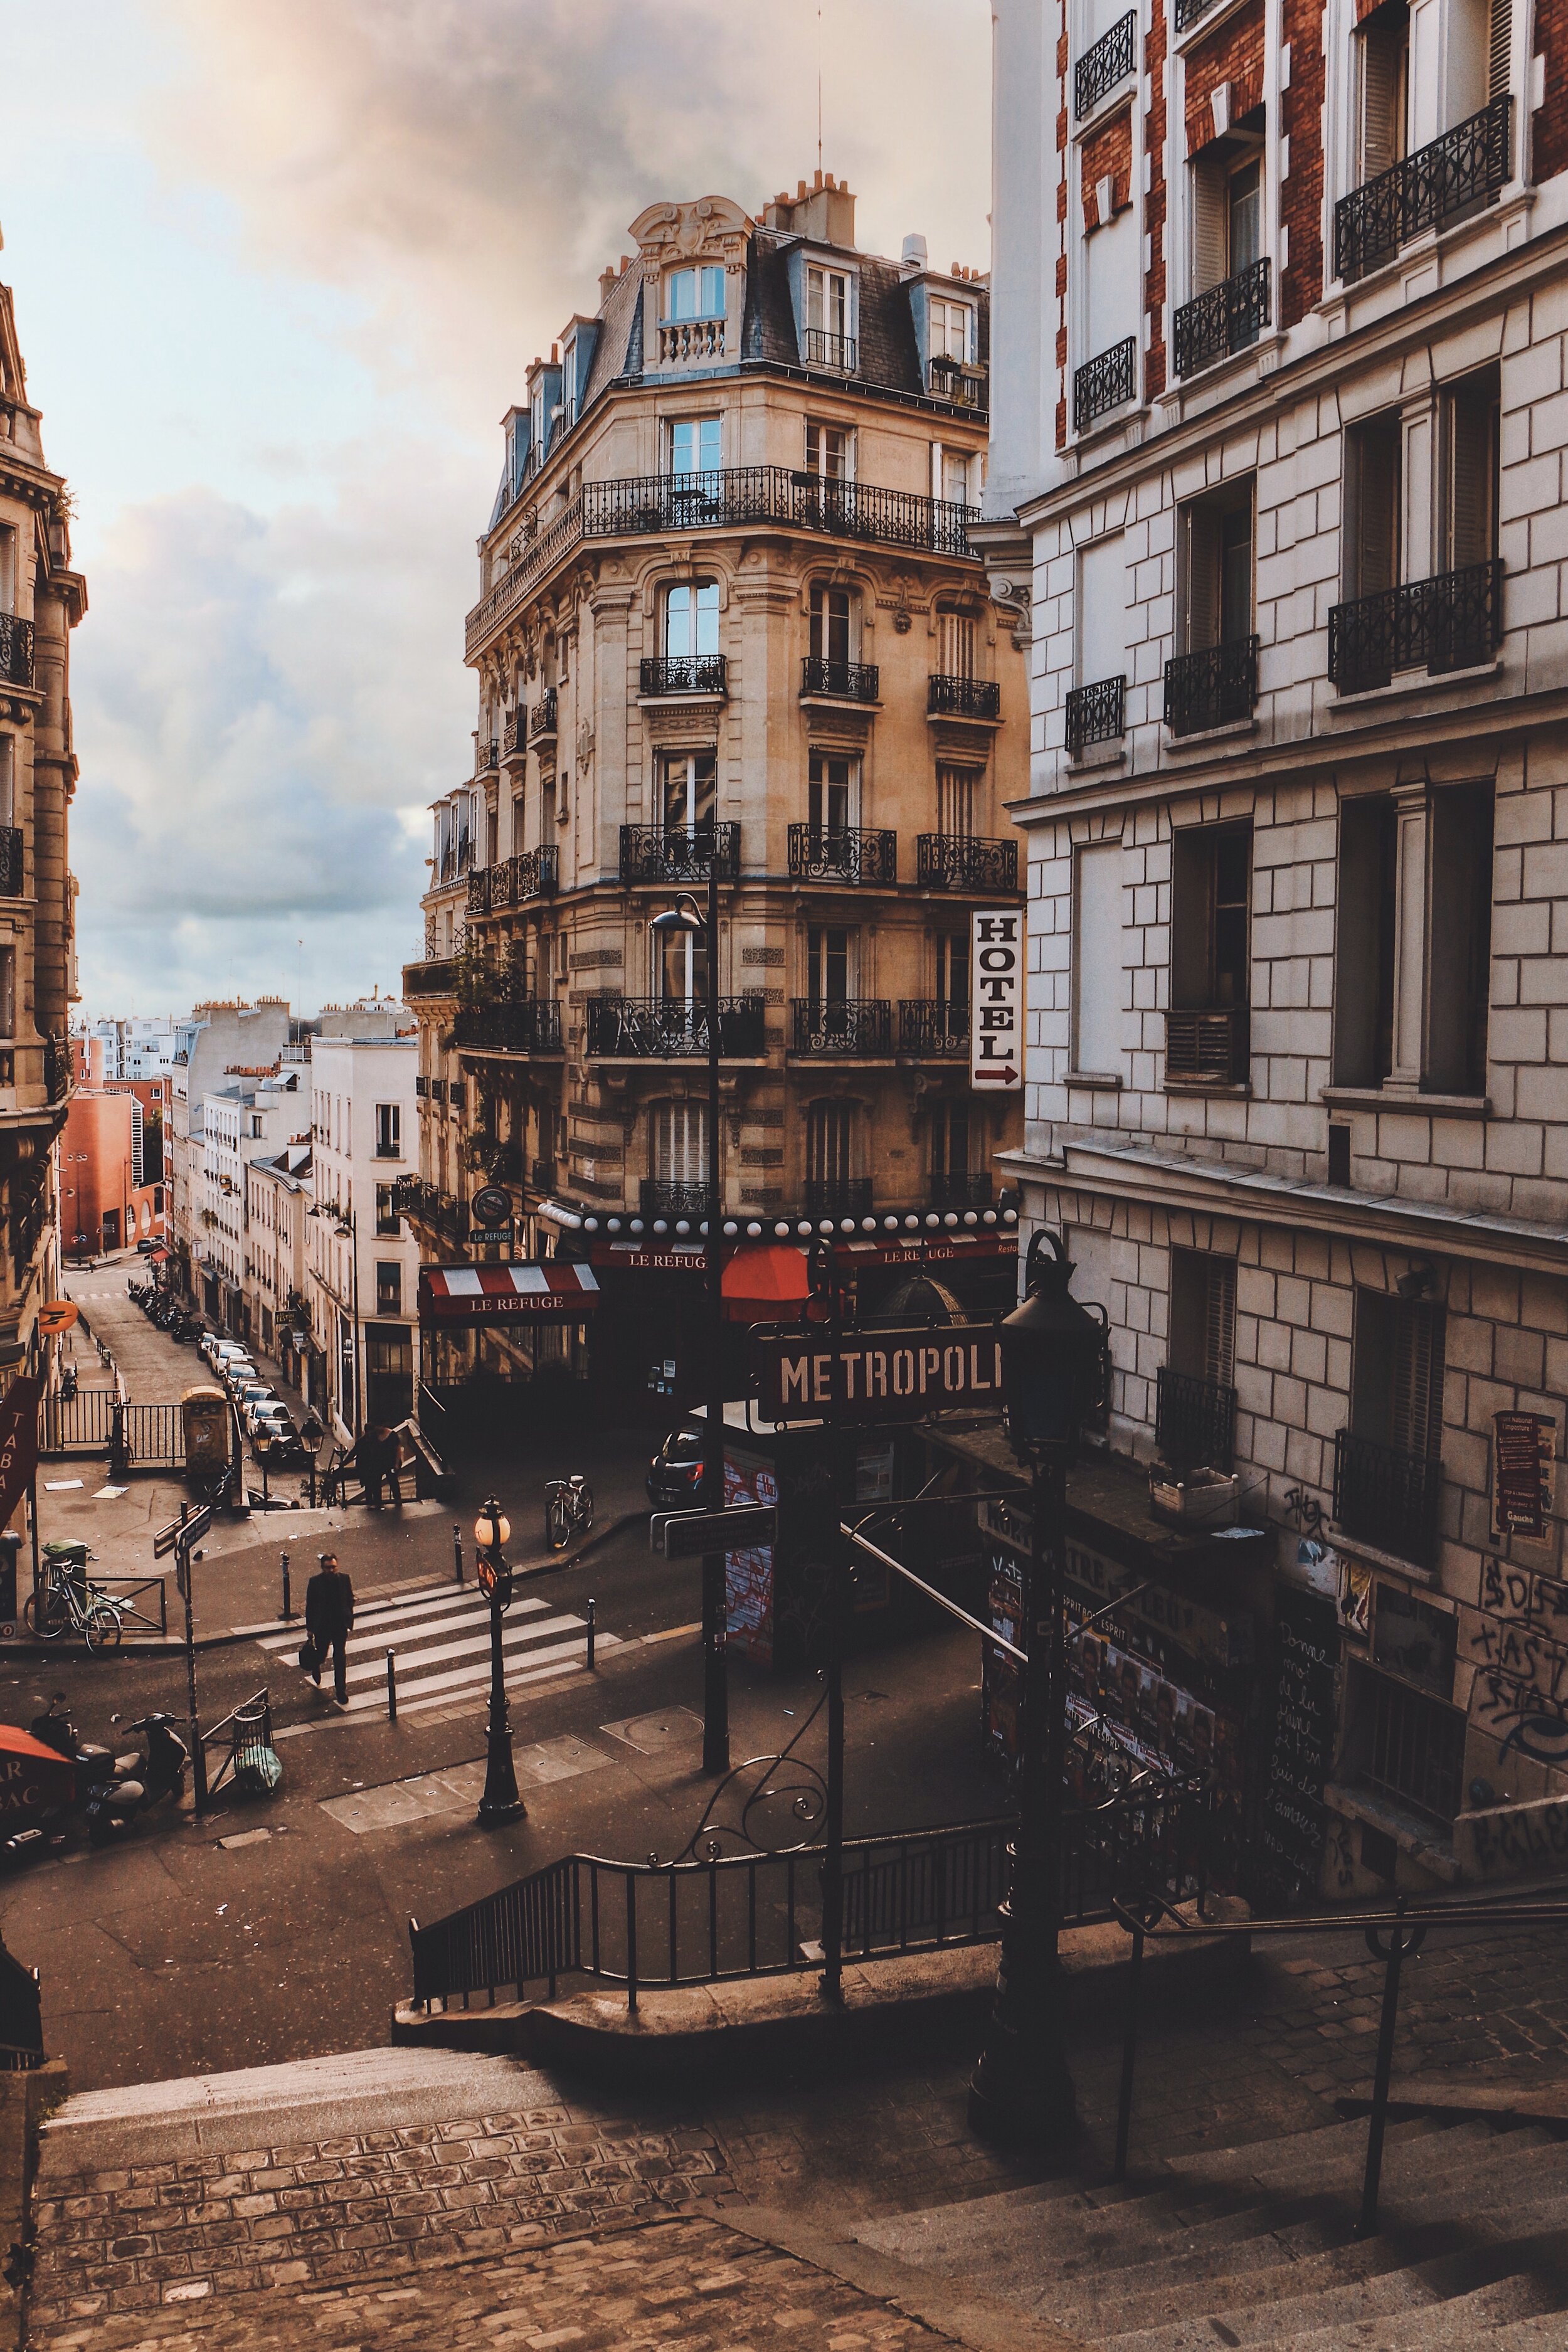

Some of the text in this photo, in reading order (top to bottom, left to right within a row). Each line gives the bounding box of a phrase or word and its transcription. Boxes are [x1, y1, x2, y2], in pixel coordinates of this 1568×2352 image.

[977, 918, 1017, 1060] HOTEL
[474, 1231, 512, 1242] Le REFUGE
[629, 1254, 709, 1269] LE REFUG
[884, 1246, 954, 1263] LE REUGE
[470, 1296, 564, 1311] LE REFUGE
[0, 1411, 25, 1498] TABA
[1507, 1510, 1534, 1524] Gauche
[1101, 1618, 1126, 1642] ESPRIT
[0, 1785, 39, 1810] AC
